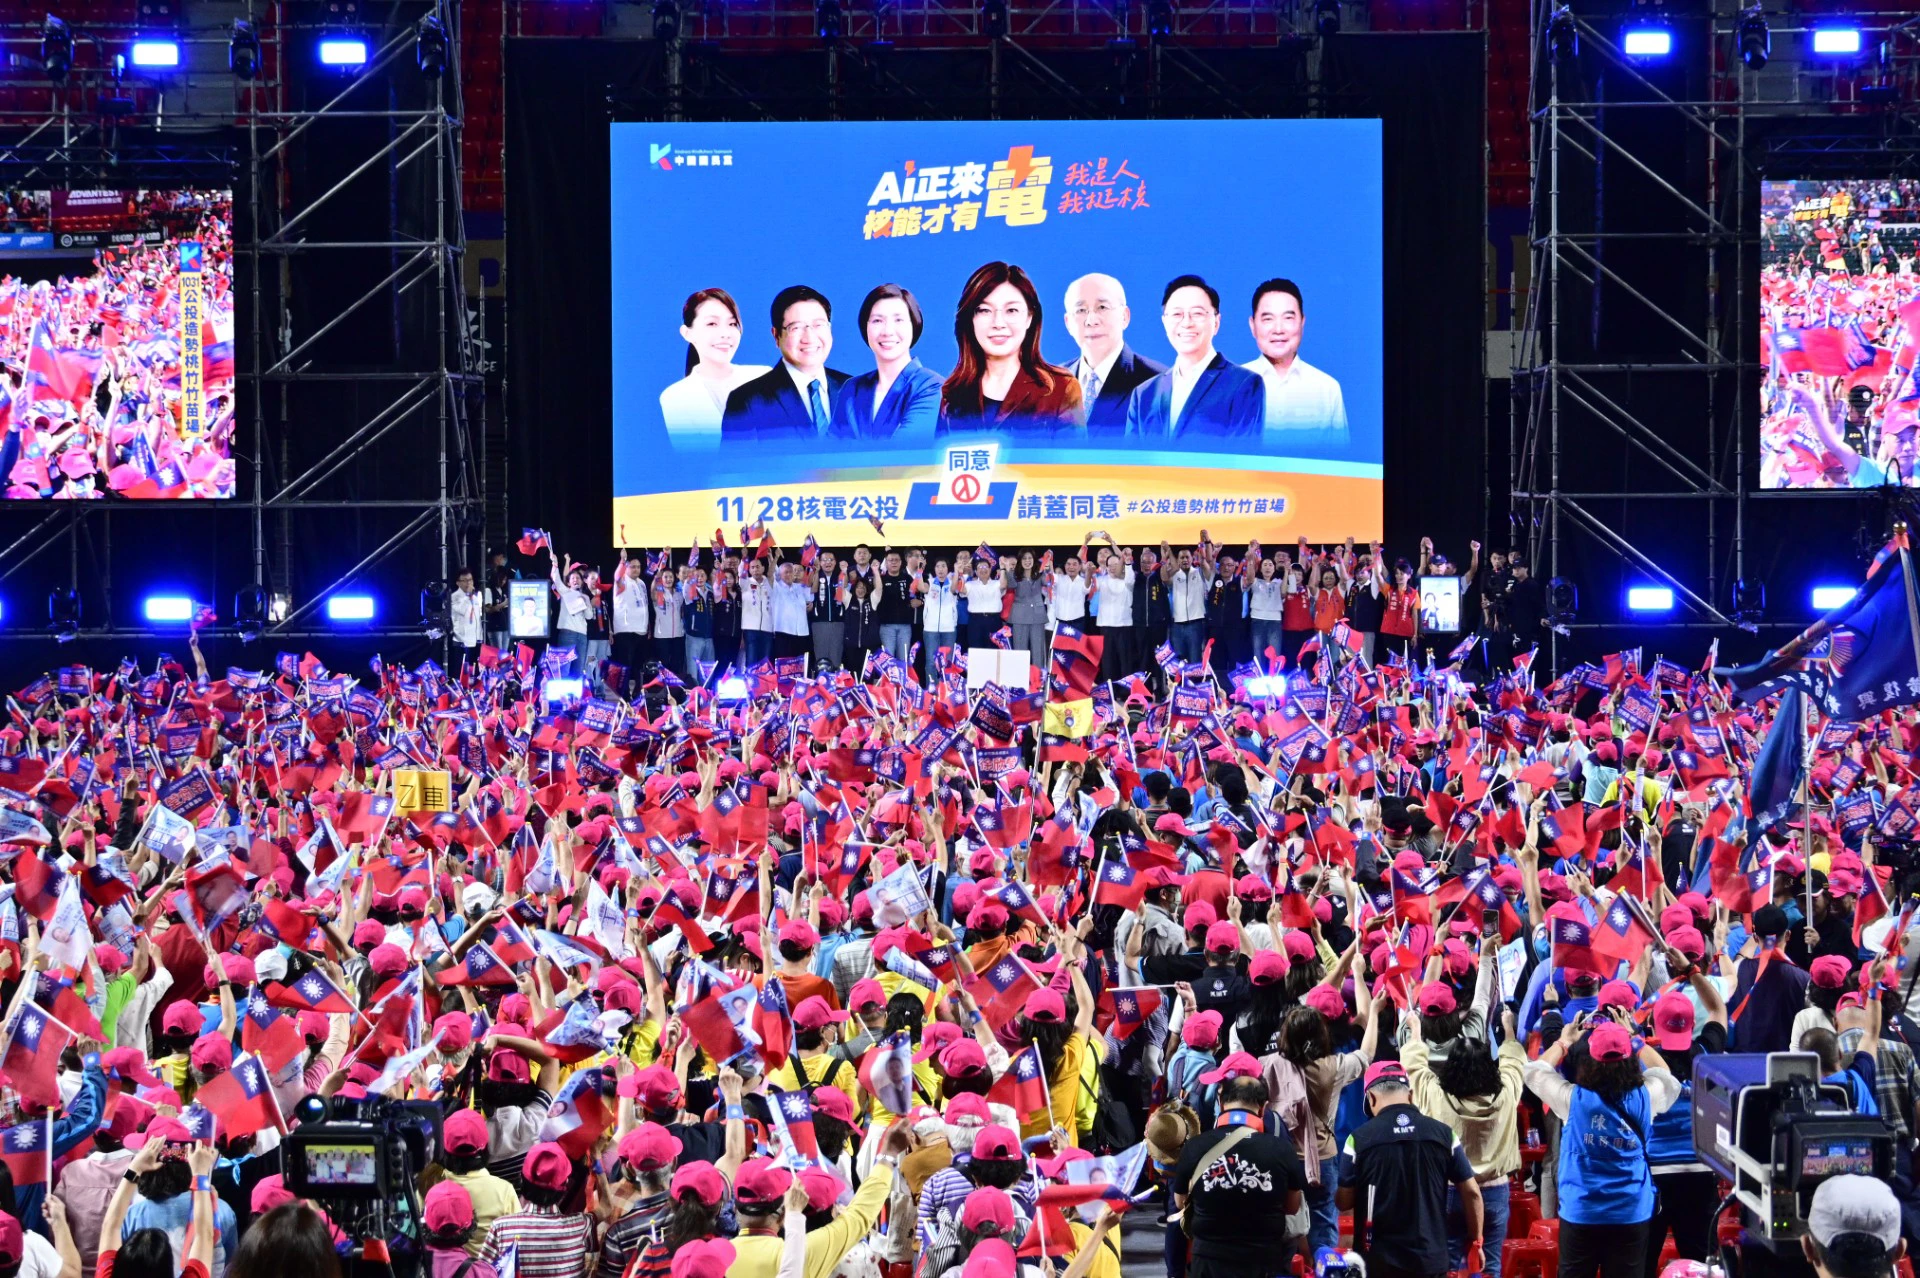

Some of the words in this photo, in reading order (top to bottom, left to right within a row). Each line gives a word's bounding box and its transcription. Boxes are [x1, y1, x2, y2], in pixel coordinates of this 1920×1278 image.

[863, 201, 982, 240] 核能才有
[949, 450, 990, 471] 同意
[1017, 493, 1120, 519] 請蓋同意
[400, 784, 444, 809] 乙車
